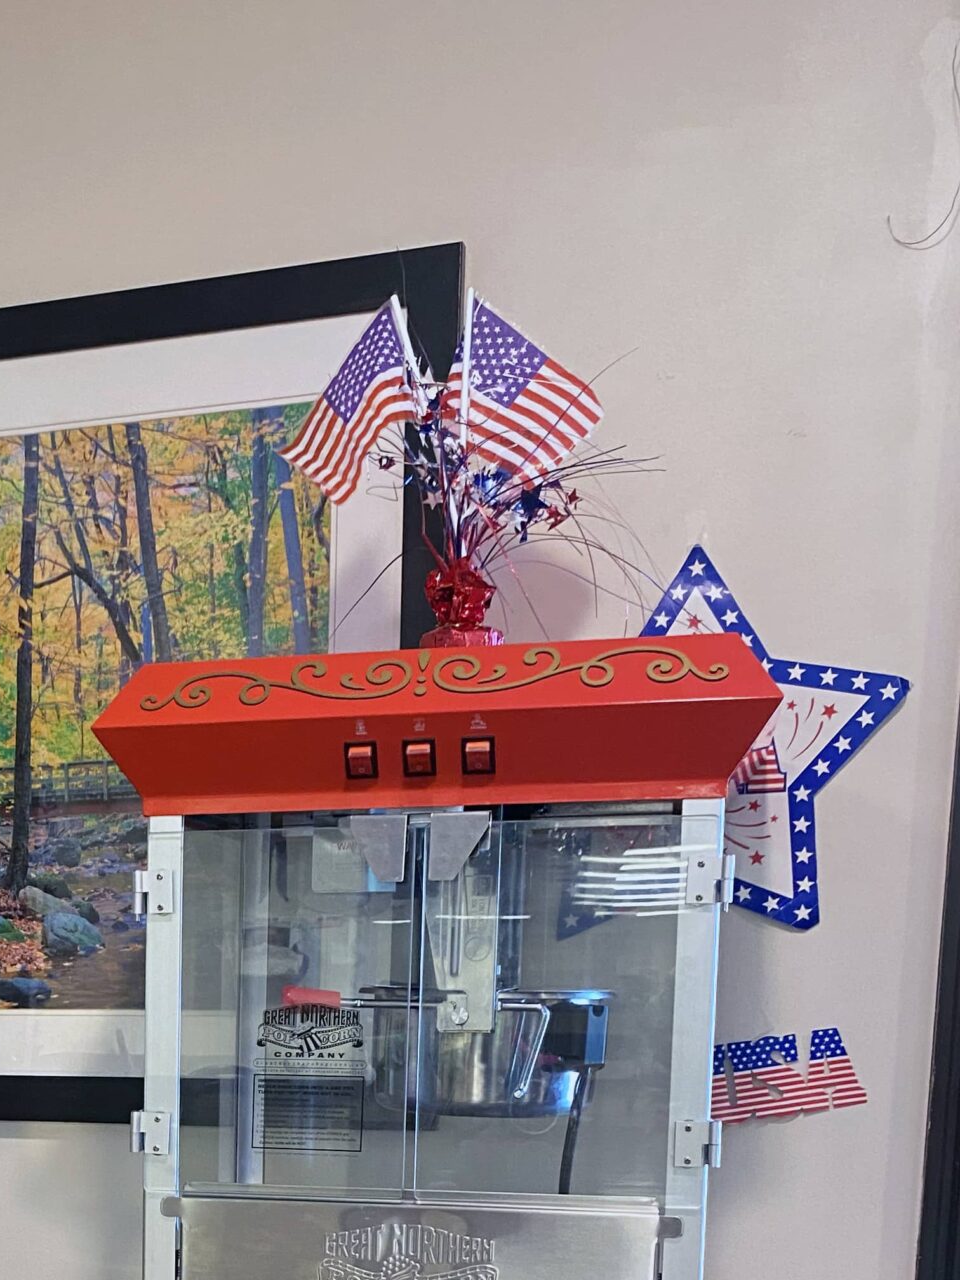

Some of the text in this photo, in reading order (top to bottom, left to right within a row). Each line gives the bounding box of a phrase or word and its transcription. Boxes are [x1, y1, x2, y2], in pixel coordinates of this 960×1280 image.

[264, 1003, 360, 1028] GREAT NORTHERN
[319, 1026, 362, 1045] CORN
[273, 1051, 346, 1059] COMPANY
[711, 1027, 868, 1124] USA
[325, 1223, 496, 1263] GREAT NORTHERN
